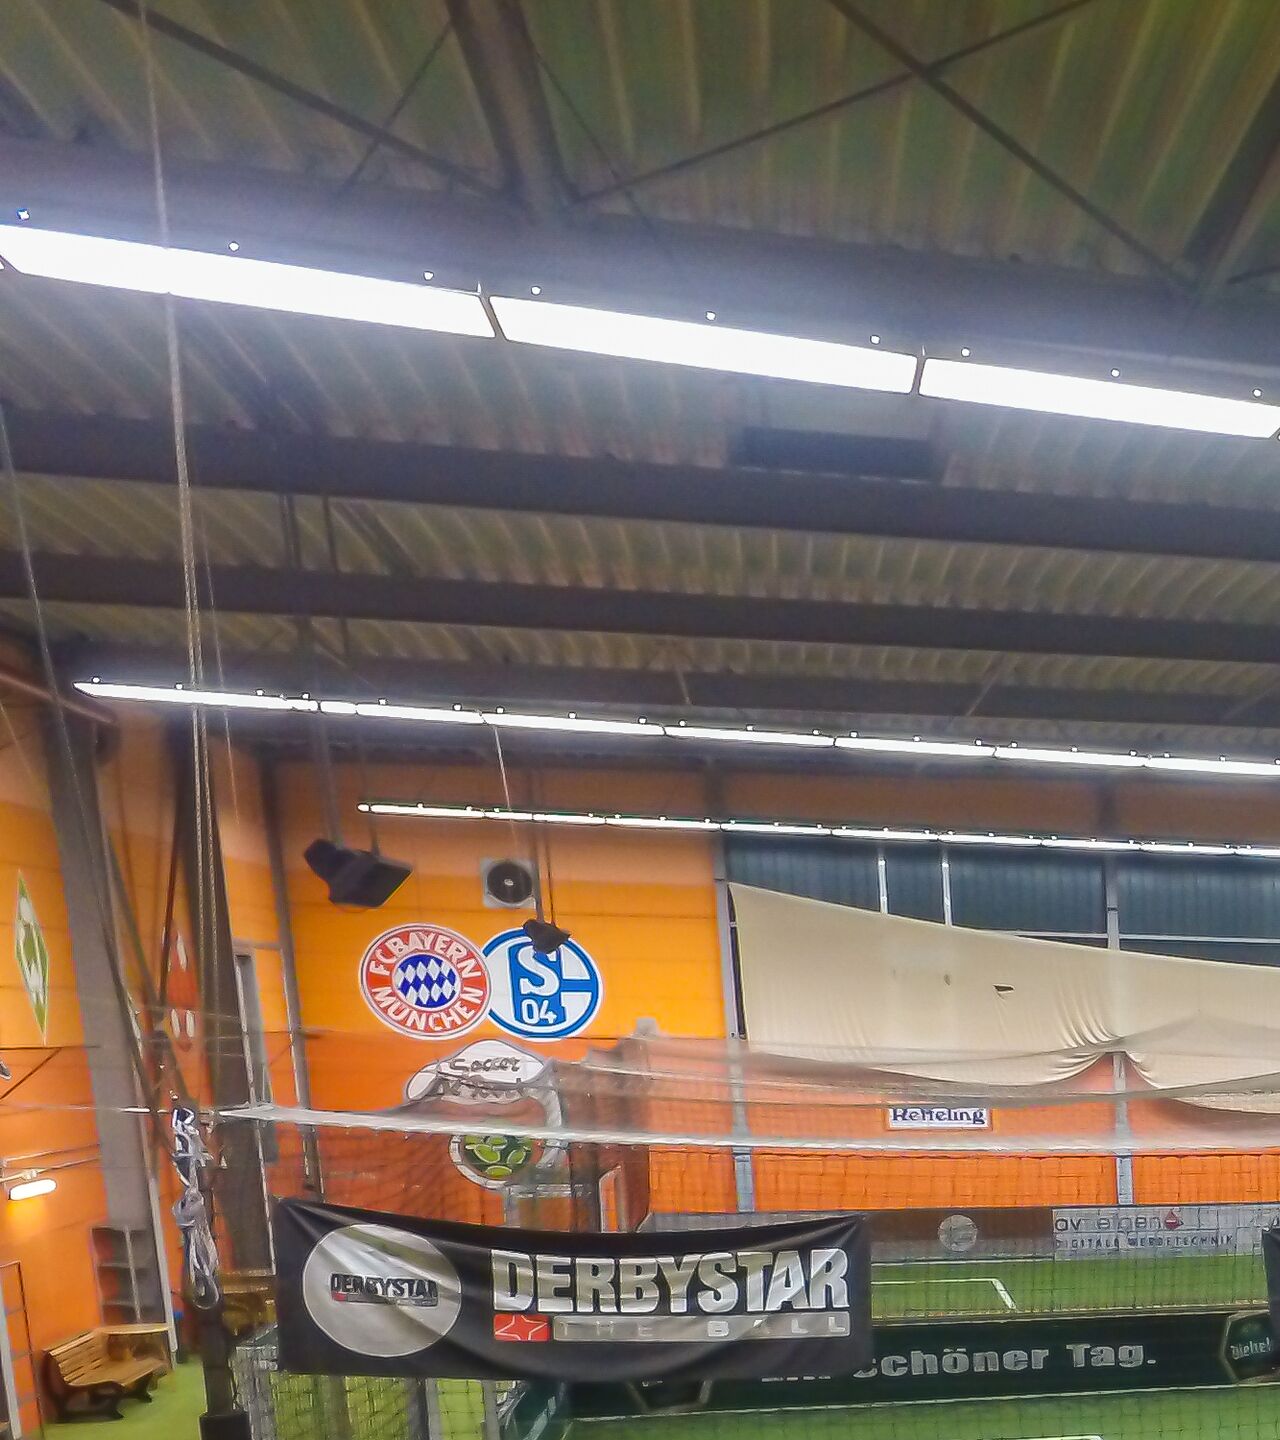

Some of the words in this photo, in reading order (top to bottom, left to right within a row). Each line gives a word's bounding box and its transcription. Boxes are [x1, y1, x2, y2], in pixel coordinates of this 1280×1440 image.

[386, 931, 482, 980] BAYERN
[521, 999, 557, 1024] 04
[449, 1056, 521, 1072] Soccer
[330, 1273, 439, 1299] DERBYSTAR
[491, 1249, 850, 1313] DERBYSTAR
[1065, 1342, 1157, 1368] Tag.
